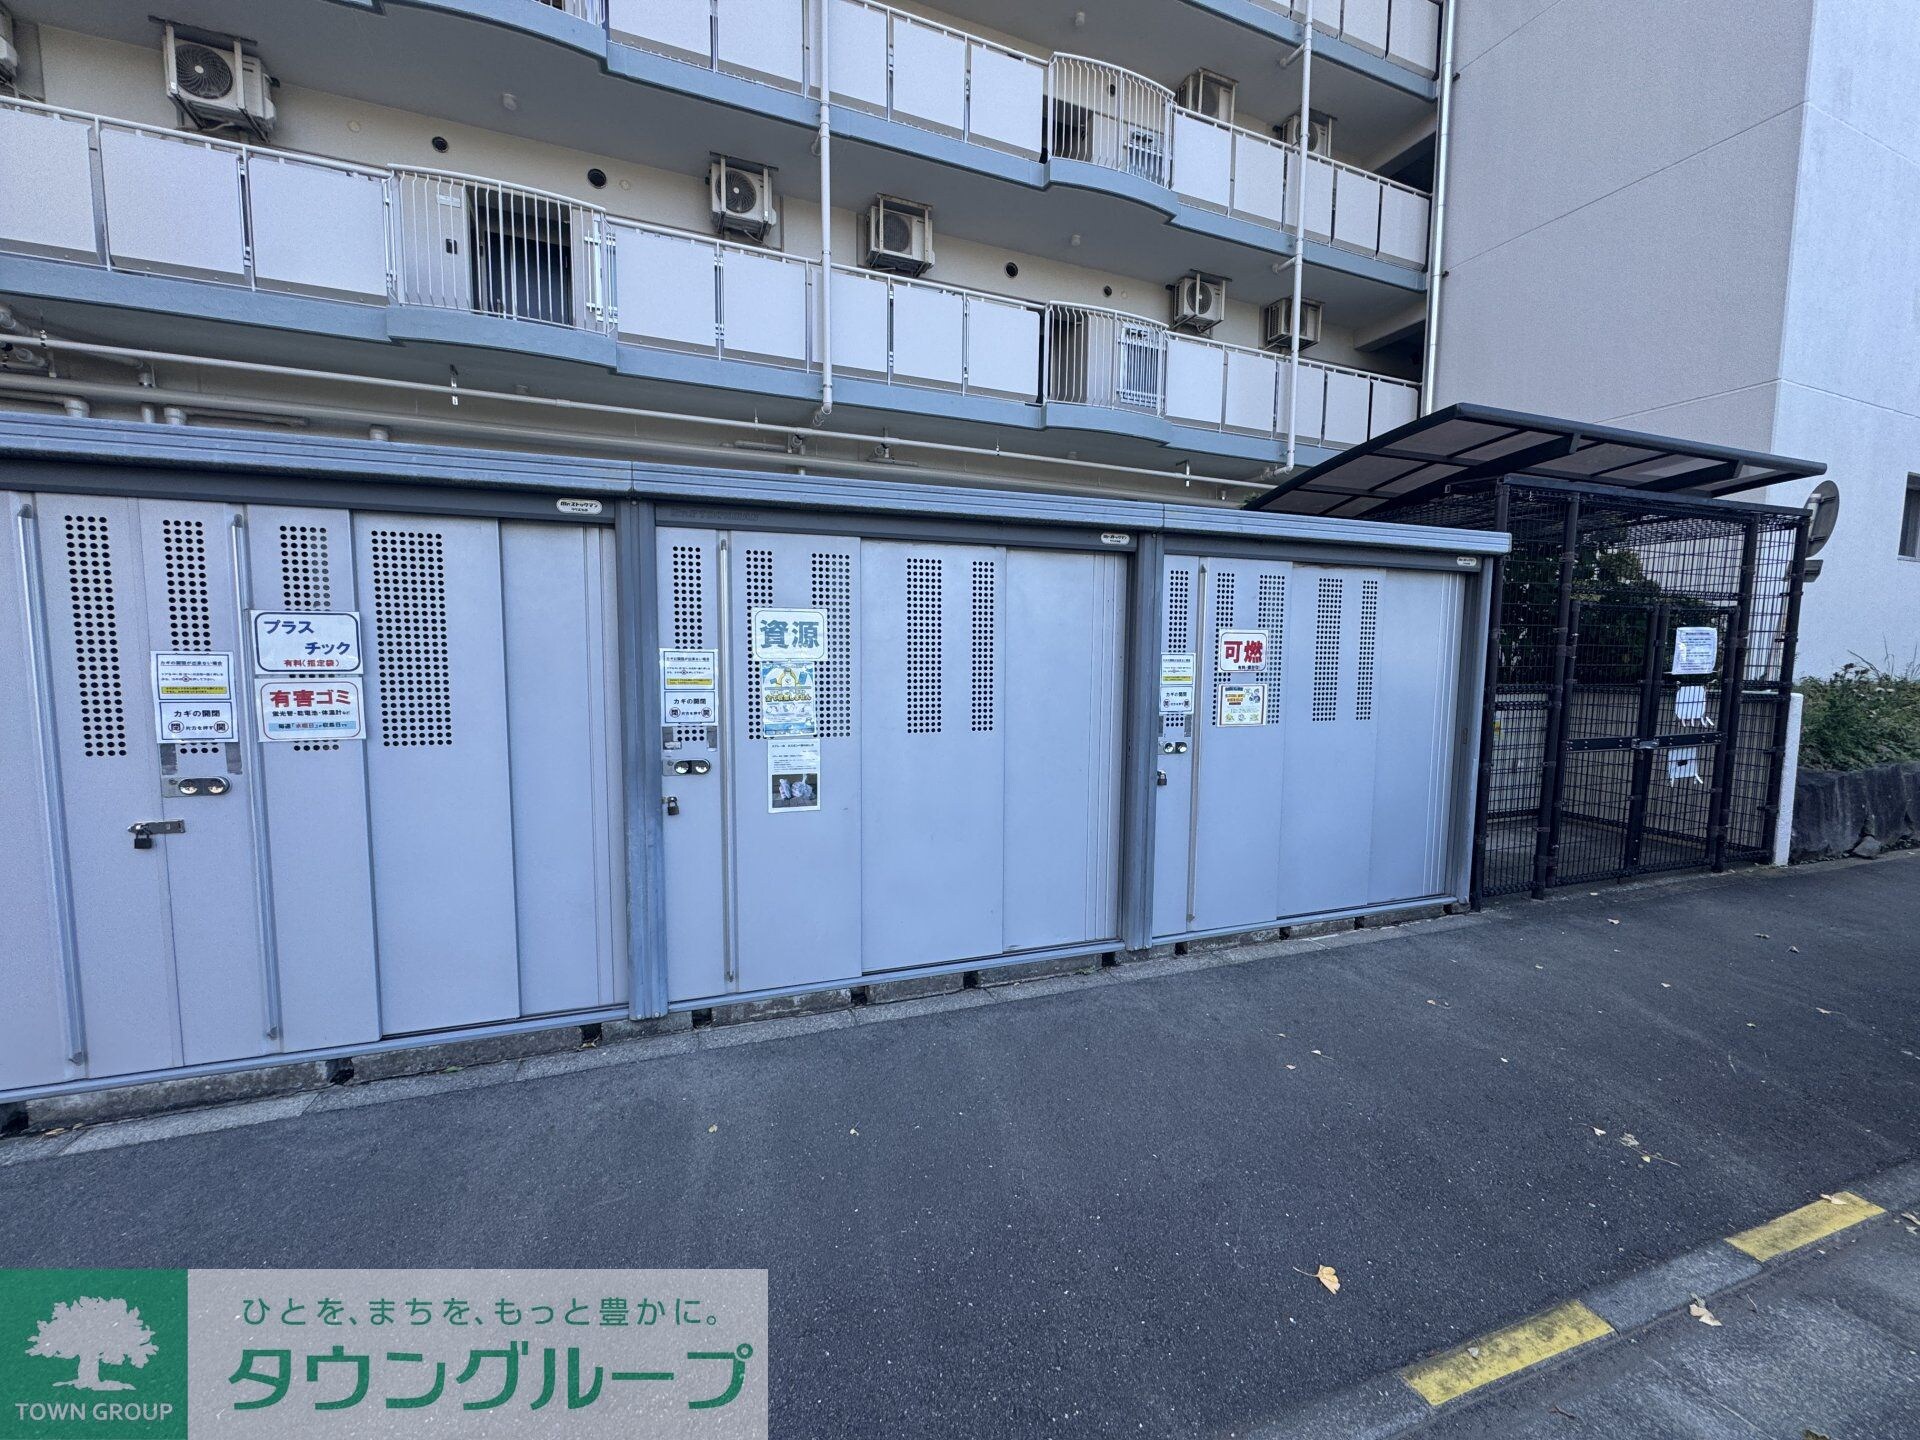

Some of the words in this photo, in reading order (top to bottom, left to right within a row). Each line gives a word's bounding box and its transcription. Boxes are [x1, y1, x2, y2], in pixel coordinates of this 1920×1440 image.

[263, 619, 315, 635] プラス
[760, 619, 820, 649] 資源
[304, 641, 351, 656] チック
[1223, 640, 1264, 664] 可燃
[269, 689, 352, 708] 有害ゴミ
[173, 709, 221, 718] カギの開閉
